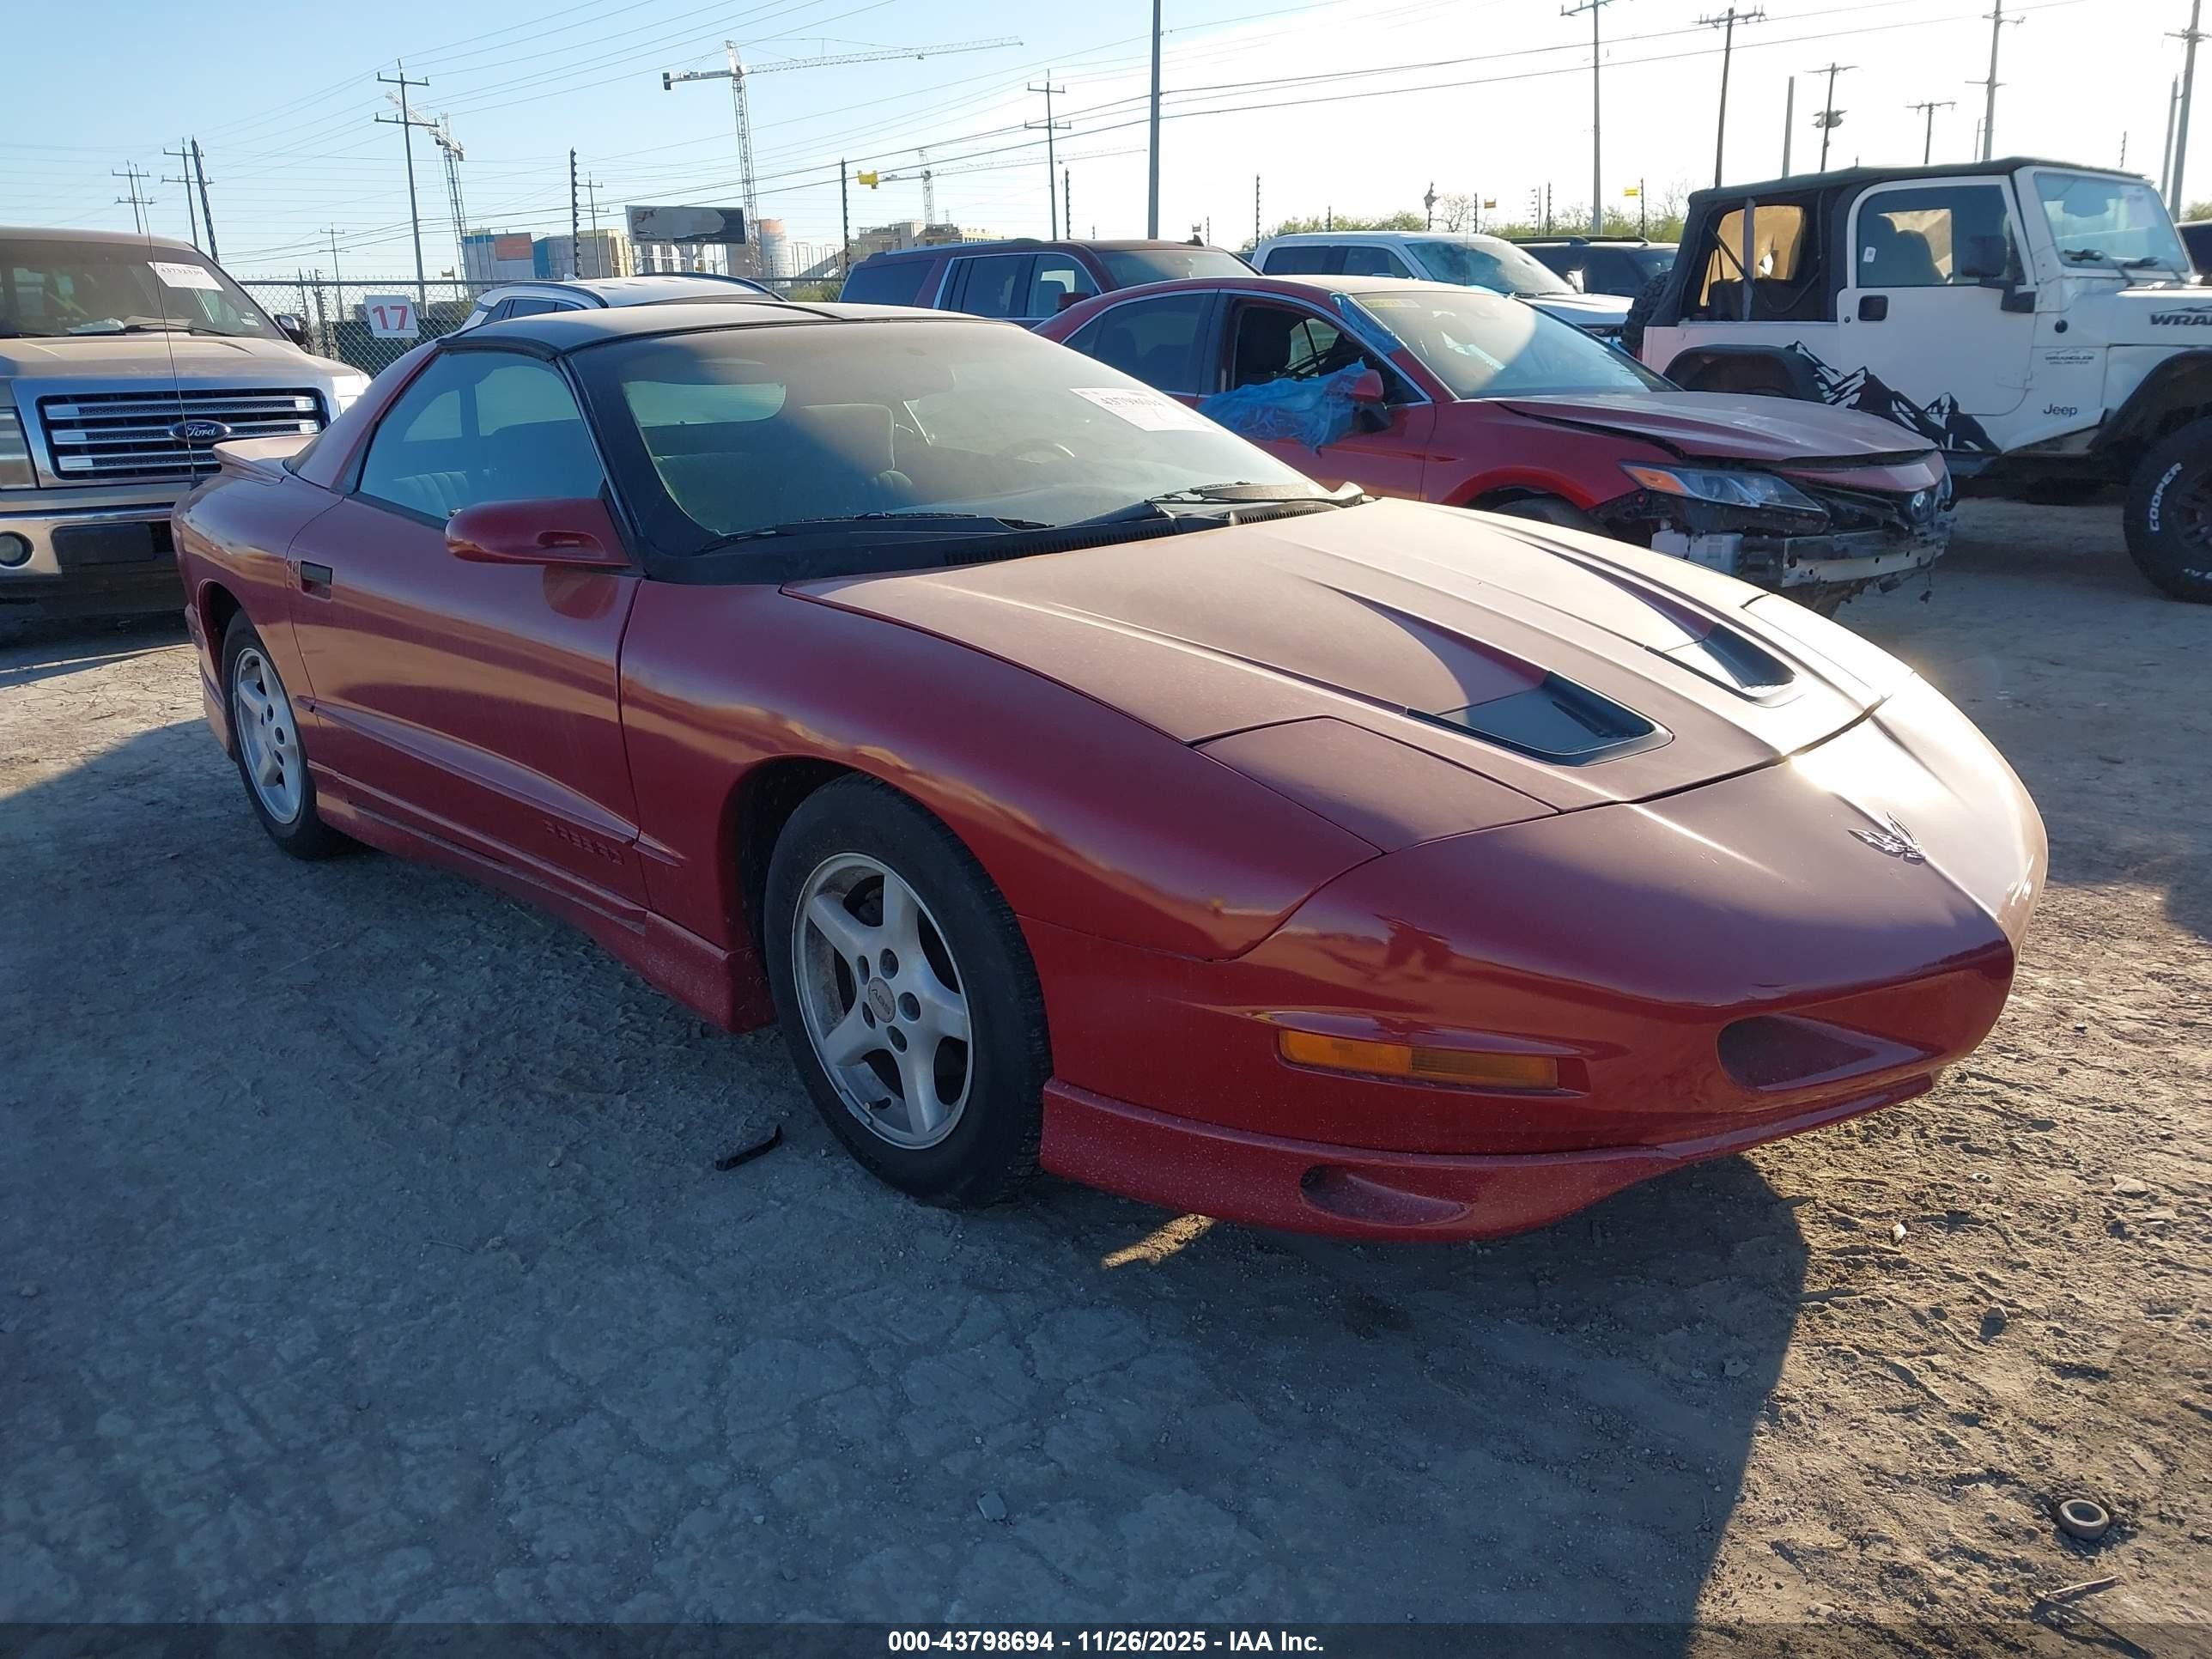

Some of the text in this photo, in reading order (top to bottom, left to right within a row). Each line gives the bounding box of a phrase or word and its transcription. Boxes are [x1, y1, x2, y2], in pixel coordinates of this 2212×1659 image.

[372, 305, 408, 331] 17
[2150, 314, 2212, 325] WRA
[2043, 404, 2078, 418] Jeep
[187, 423, 216, 436] Ford
[2149, 462, 2183, 532] COOPER
